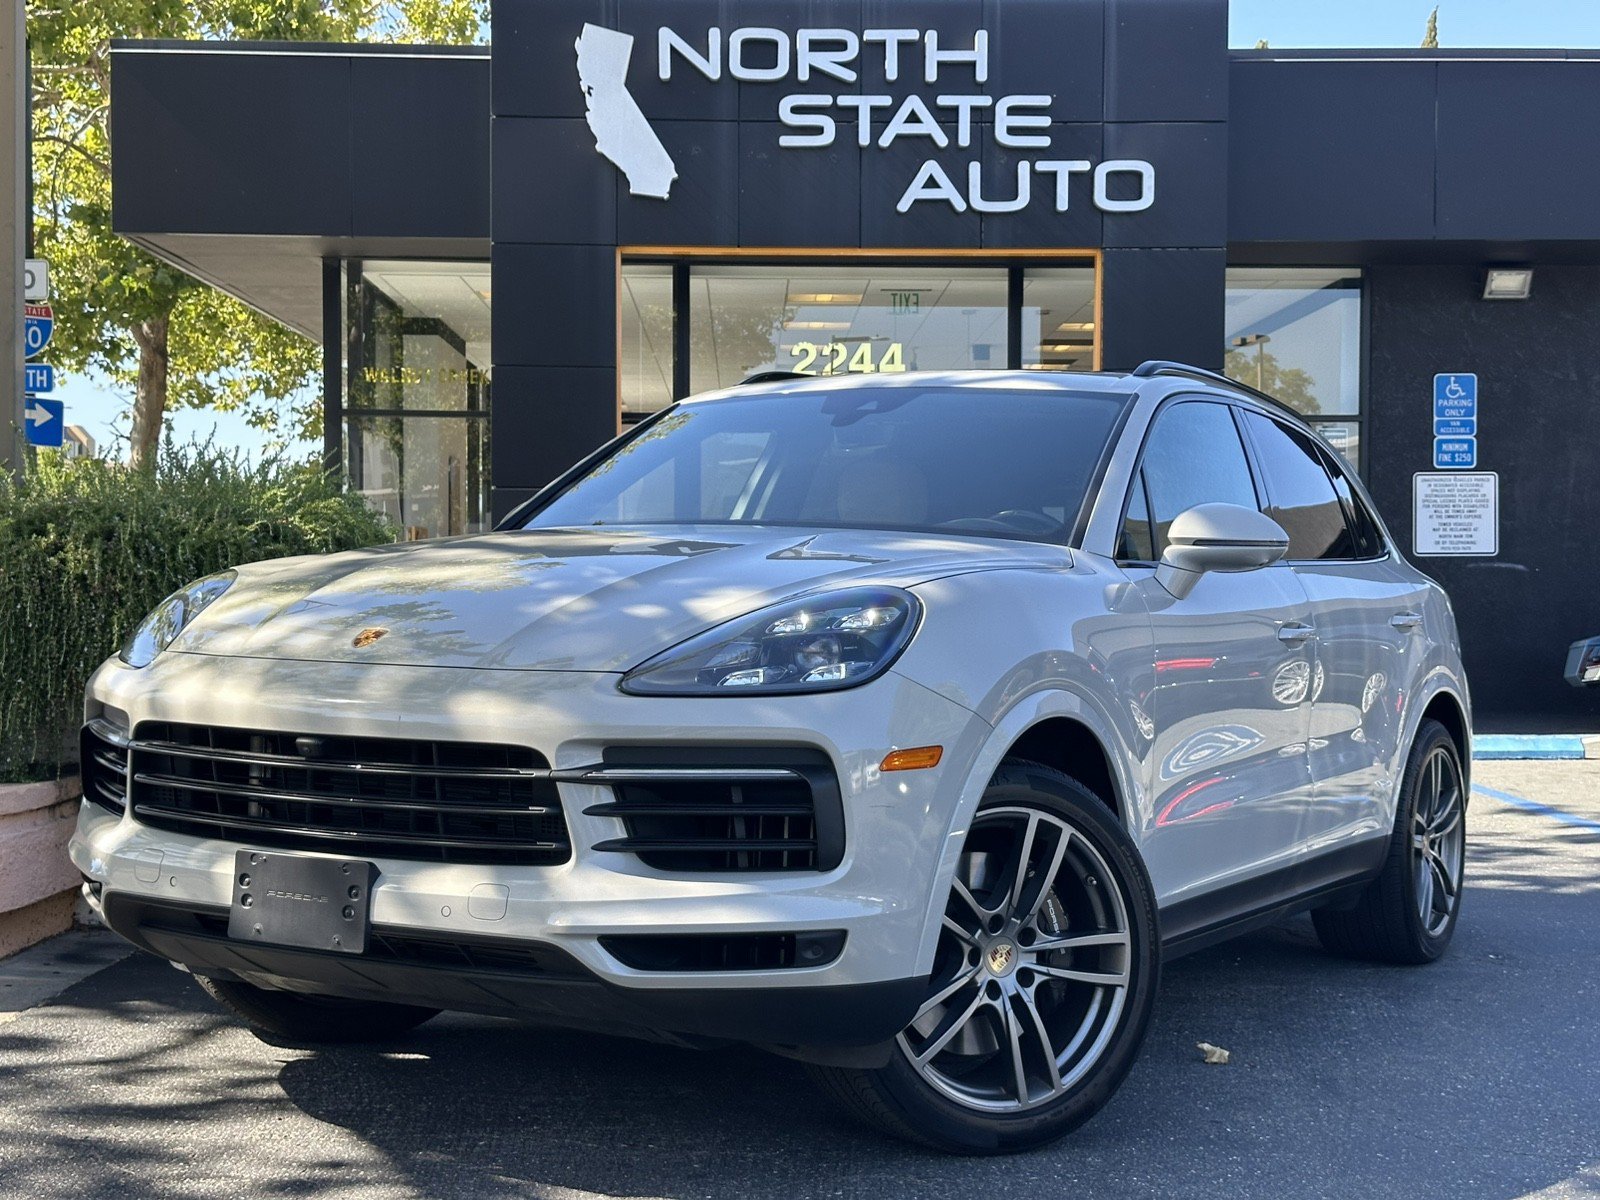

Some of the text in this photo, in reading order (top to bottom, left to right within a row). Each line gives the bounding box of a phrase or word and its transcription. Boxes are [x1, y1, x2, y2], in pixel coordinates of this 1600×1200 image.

[658, 26, 989, 84] NORTH
[778, 94, 1053, 148] STATE
[896, 159, 1156, 213] AUTO
[25, 325, 42, 348] 0
[790, 341, 906, 376] 2244
[1438, 399, 1472, 407] PARKING
[1438, 453, 1472, 462] FINE $250
[1442, 443, 1468, 451] MINIMUM
[266, 890, 329, 903] PORSCHE
